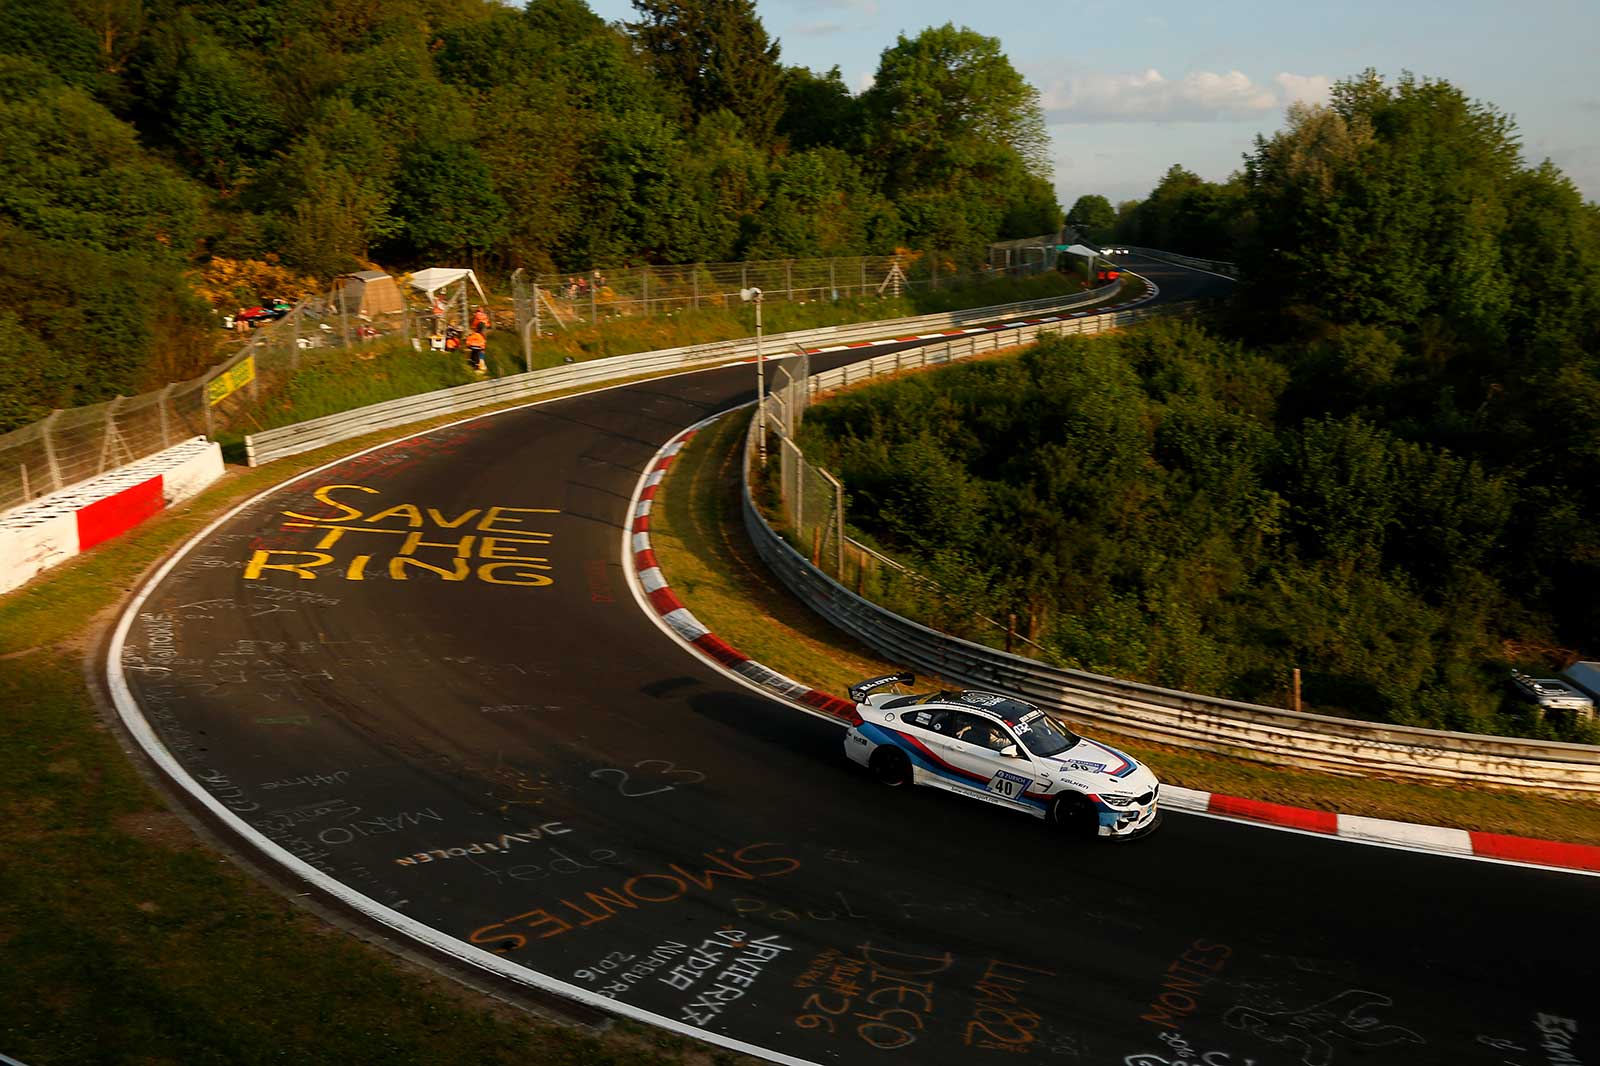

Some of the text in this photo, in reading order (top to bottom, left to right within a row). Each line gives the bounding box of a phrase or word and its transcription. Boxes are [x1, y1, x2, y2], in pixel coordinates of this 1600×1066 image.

[280, 485, 560, 537] SAVE
[281, 521, 551, 562] THE
[242, 549, 555, 587] RING
[1004, 773, 1026, 784] ZURICH
[1060, 777, 1089, 790] FALKEN
[1071, 763, 1089, 771] 40
[995, 779, 1013, 796] 40
[317, 807, 444, 845] MARIO
[573, 951, 637, 984] 2016
[657, 938, 733, 992] LYDIA
[1136, 938, 1233, 1030] MONTES
[853, 942, 957, 1050] DIEGO
